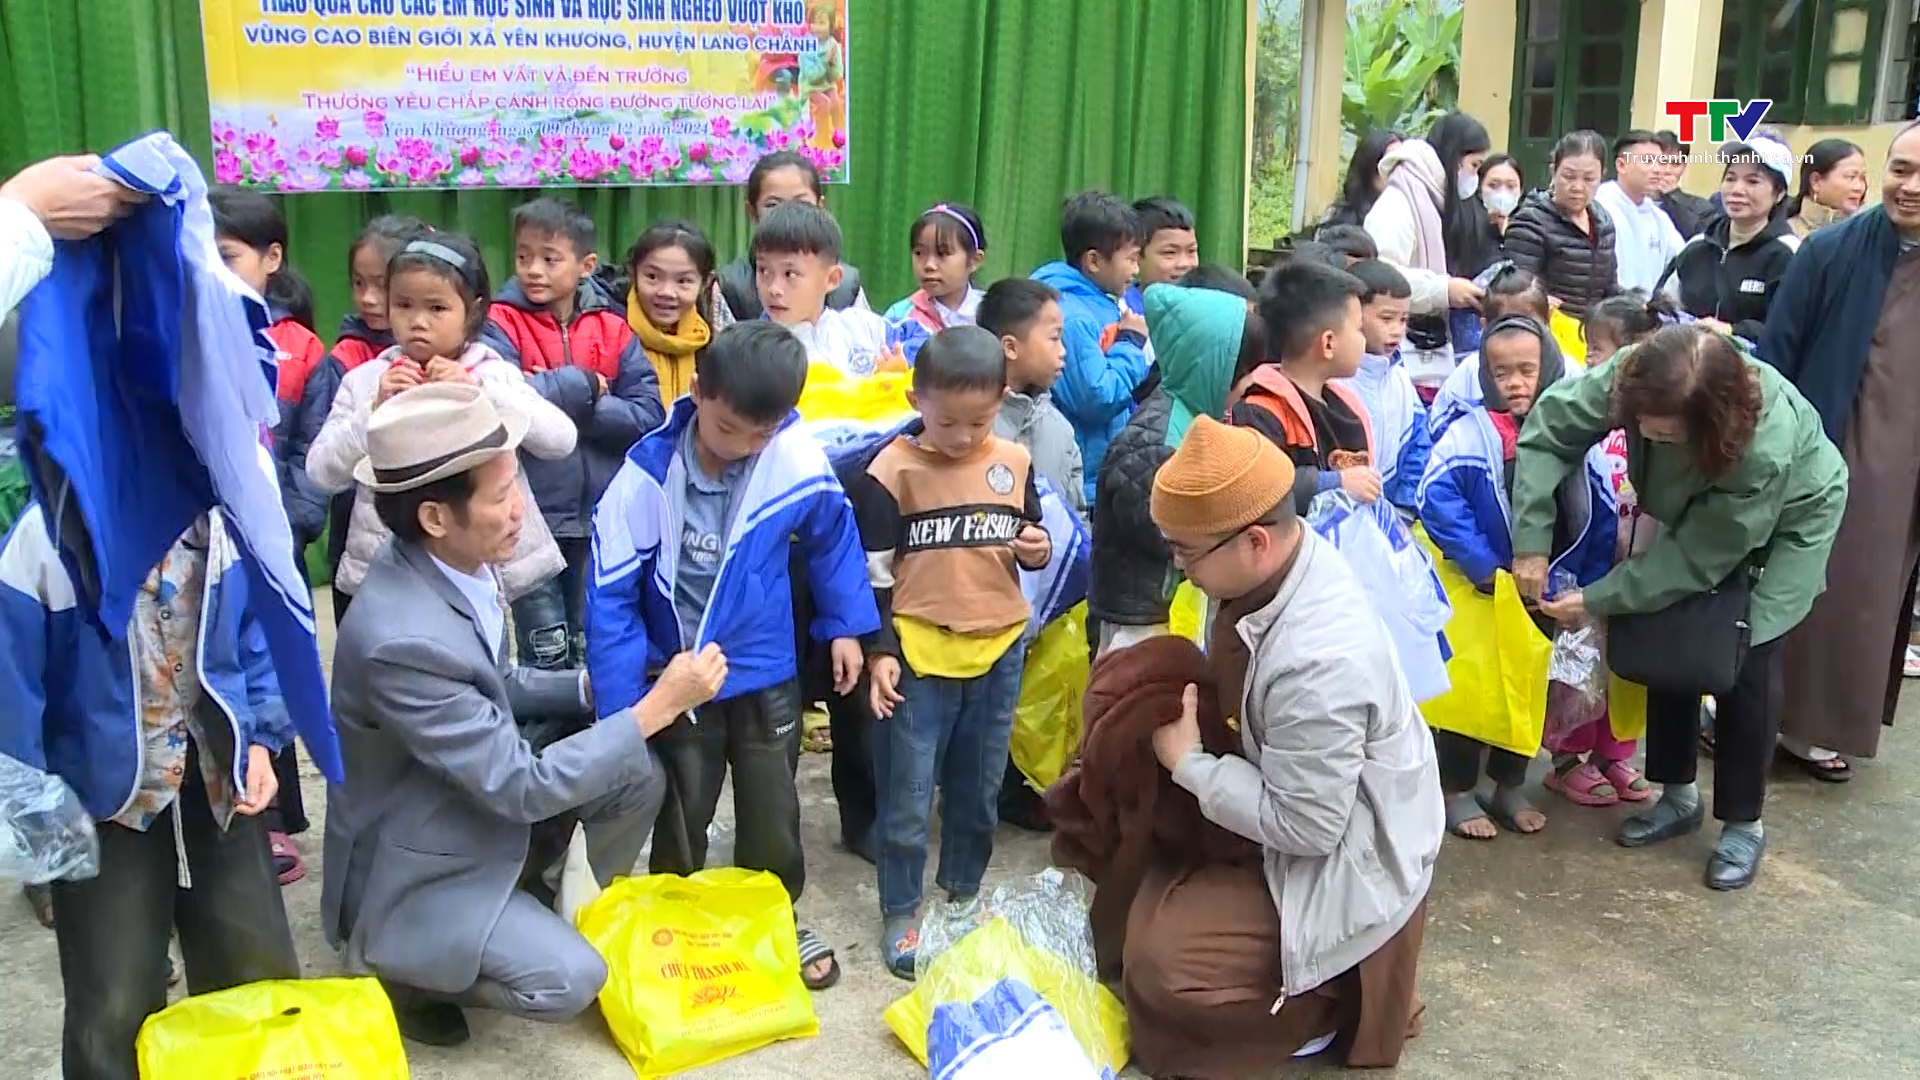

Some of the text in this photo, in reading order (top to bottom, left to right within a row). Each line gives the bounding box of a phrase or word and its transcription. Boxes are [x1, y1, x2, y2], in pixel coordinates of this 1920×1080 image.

[443, 0, 468, 16] EM
[515, 0, 555, 18] SINH
[628, 0, 665, 21] SINH
[245, 23, 307, 44] VÙNG
[313, 28, 361, 45] CAO
[368, 25, 411, 45] BIÊN
[418, 26, 462, 46] GIỚI
[503, 27, 538, 47] YÊN
[545, 30, 632, 51] KHƯƠNG,
[638, 31, 696, 53] HUYỆN
[702, 35, 749, 50] LANG
[755, 33, 817, 52] CHÁNH
[470, 68, 497, 82] EM
[573, 65, 610, 83] ĐẾN
[614, 66, 688, 84] TRƯỜNG
[302, 91, 389, 110] THƯƠNG
[610, 91, 673, 109] ĐƯỜNG
[384, 122, 415, 137] Yên
[541, 122, 560, 137] 09
[563, 121, 610, 139] tháng
[616, 122, 633, 137] 12
[638, 124, 671, 137] năm
[674, 122, 708, 136] 2024
[909, 516, 961, 546] NEW
